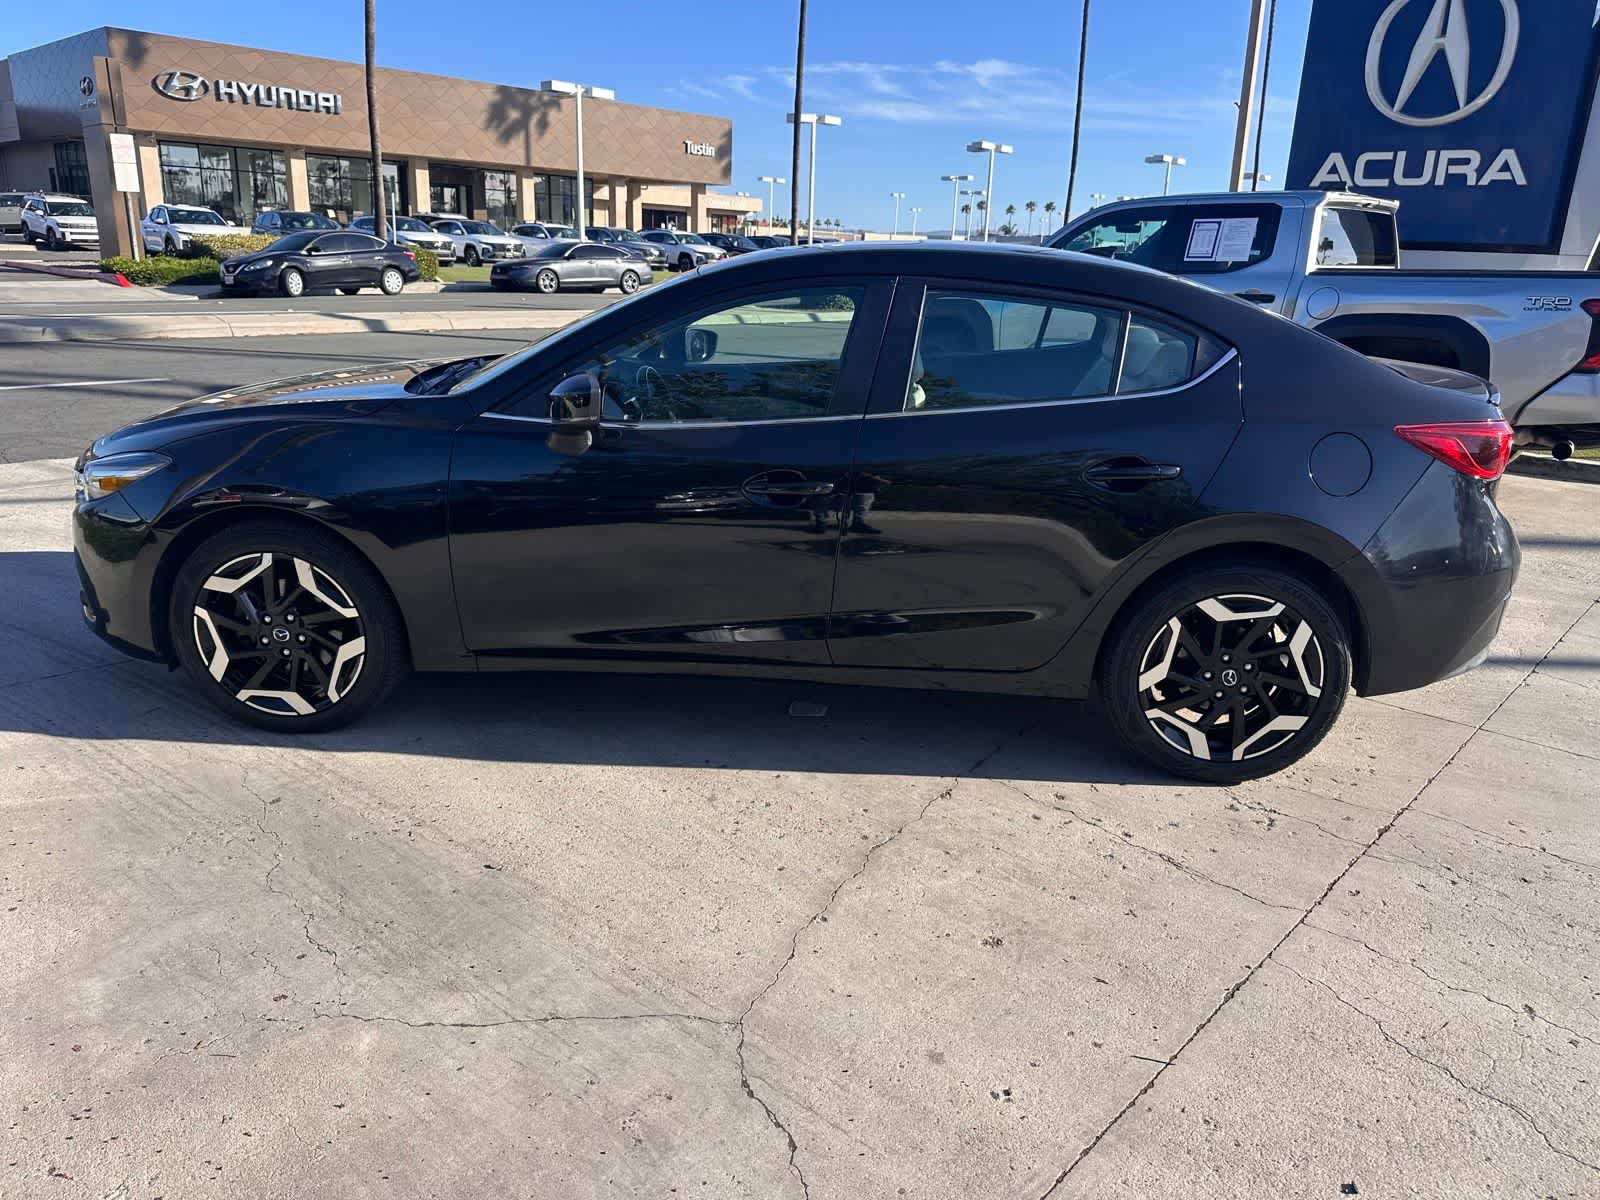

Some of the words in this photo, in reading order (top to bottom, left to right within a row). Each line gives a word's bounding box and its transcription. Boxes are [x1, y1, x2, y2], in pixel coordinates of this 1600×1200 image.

[215, 79, 342, 114] HYUNDAI
[684, 140, 716, 157] Tustin
[1309, 148, 1528, 187] ACURA
[1527, 296, 1572, 307] TRD
